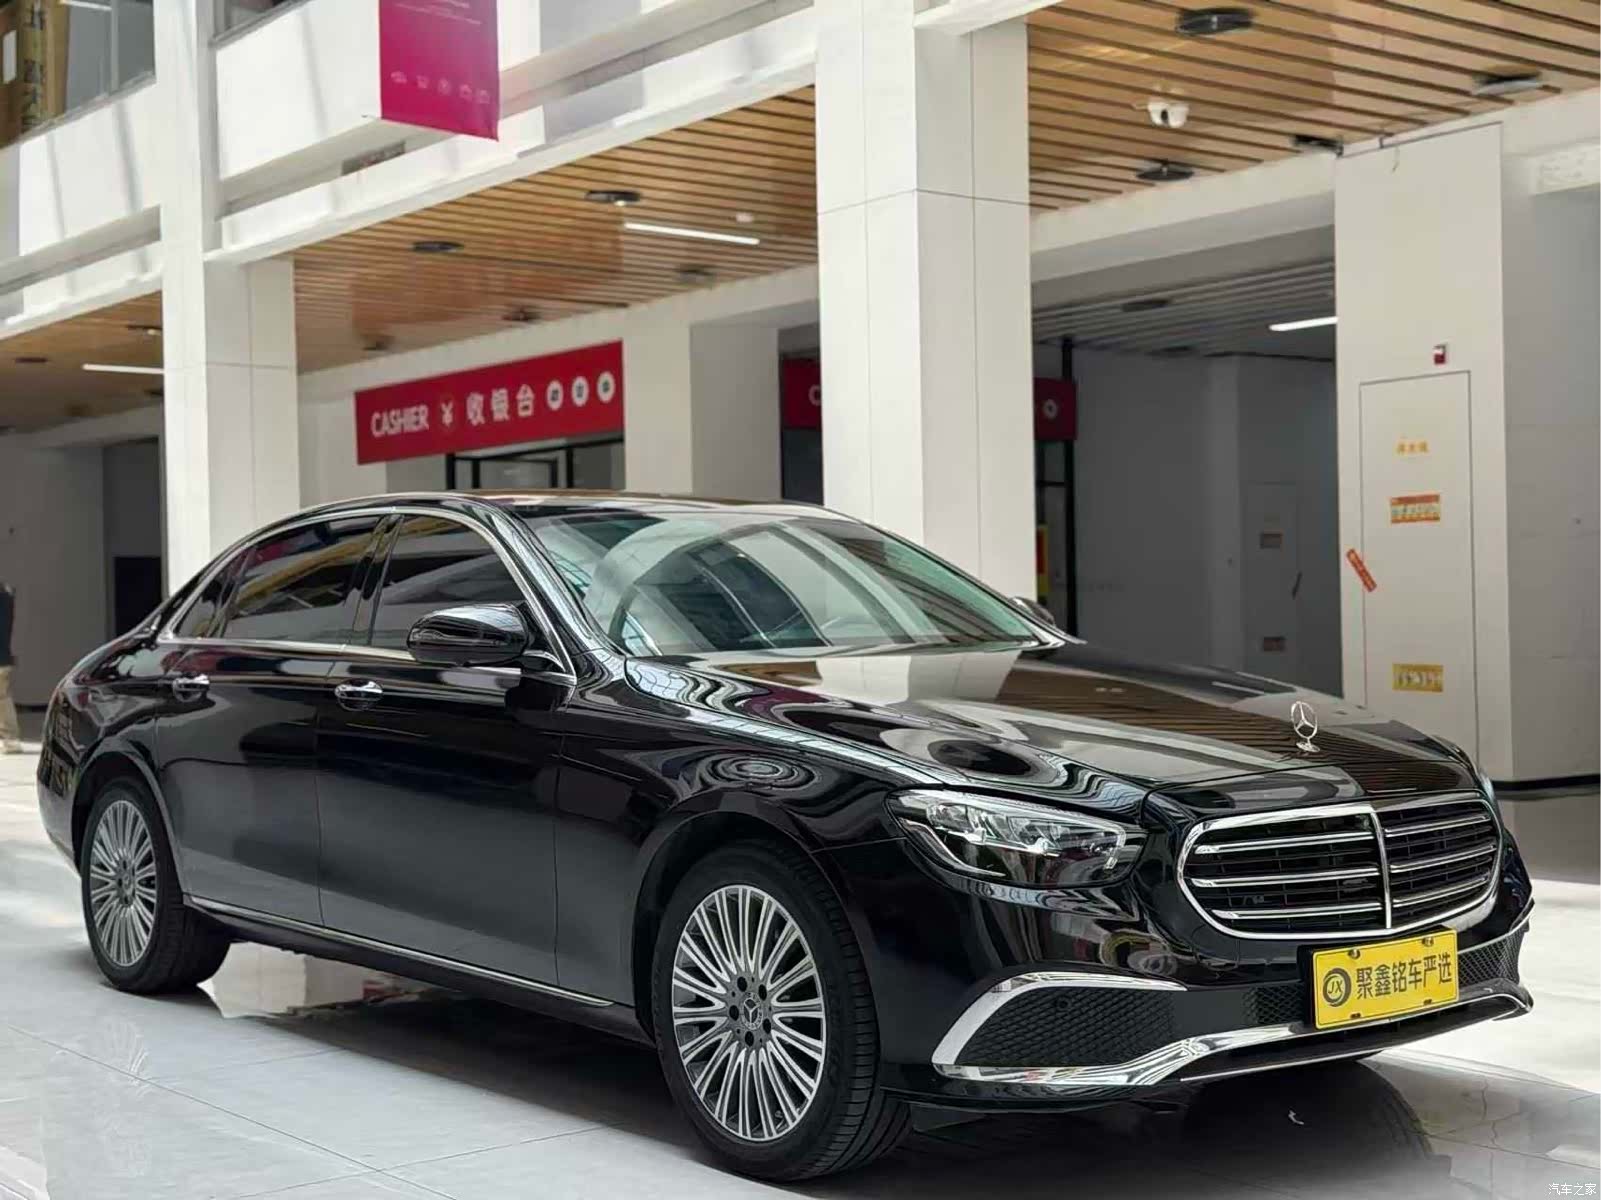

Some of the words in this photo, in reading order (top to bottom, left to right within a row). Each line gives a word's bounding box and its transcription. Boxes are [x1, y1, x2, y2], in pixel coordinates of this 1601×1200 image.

[371, 405, 429, 438] CASHIER
[466, 384, 535, 426] 收银台
[1328, 980, 1343, 994] JX
[1356, 952, 1452, 1000] 聚鑫铭车严选
